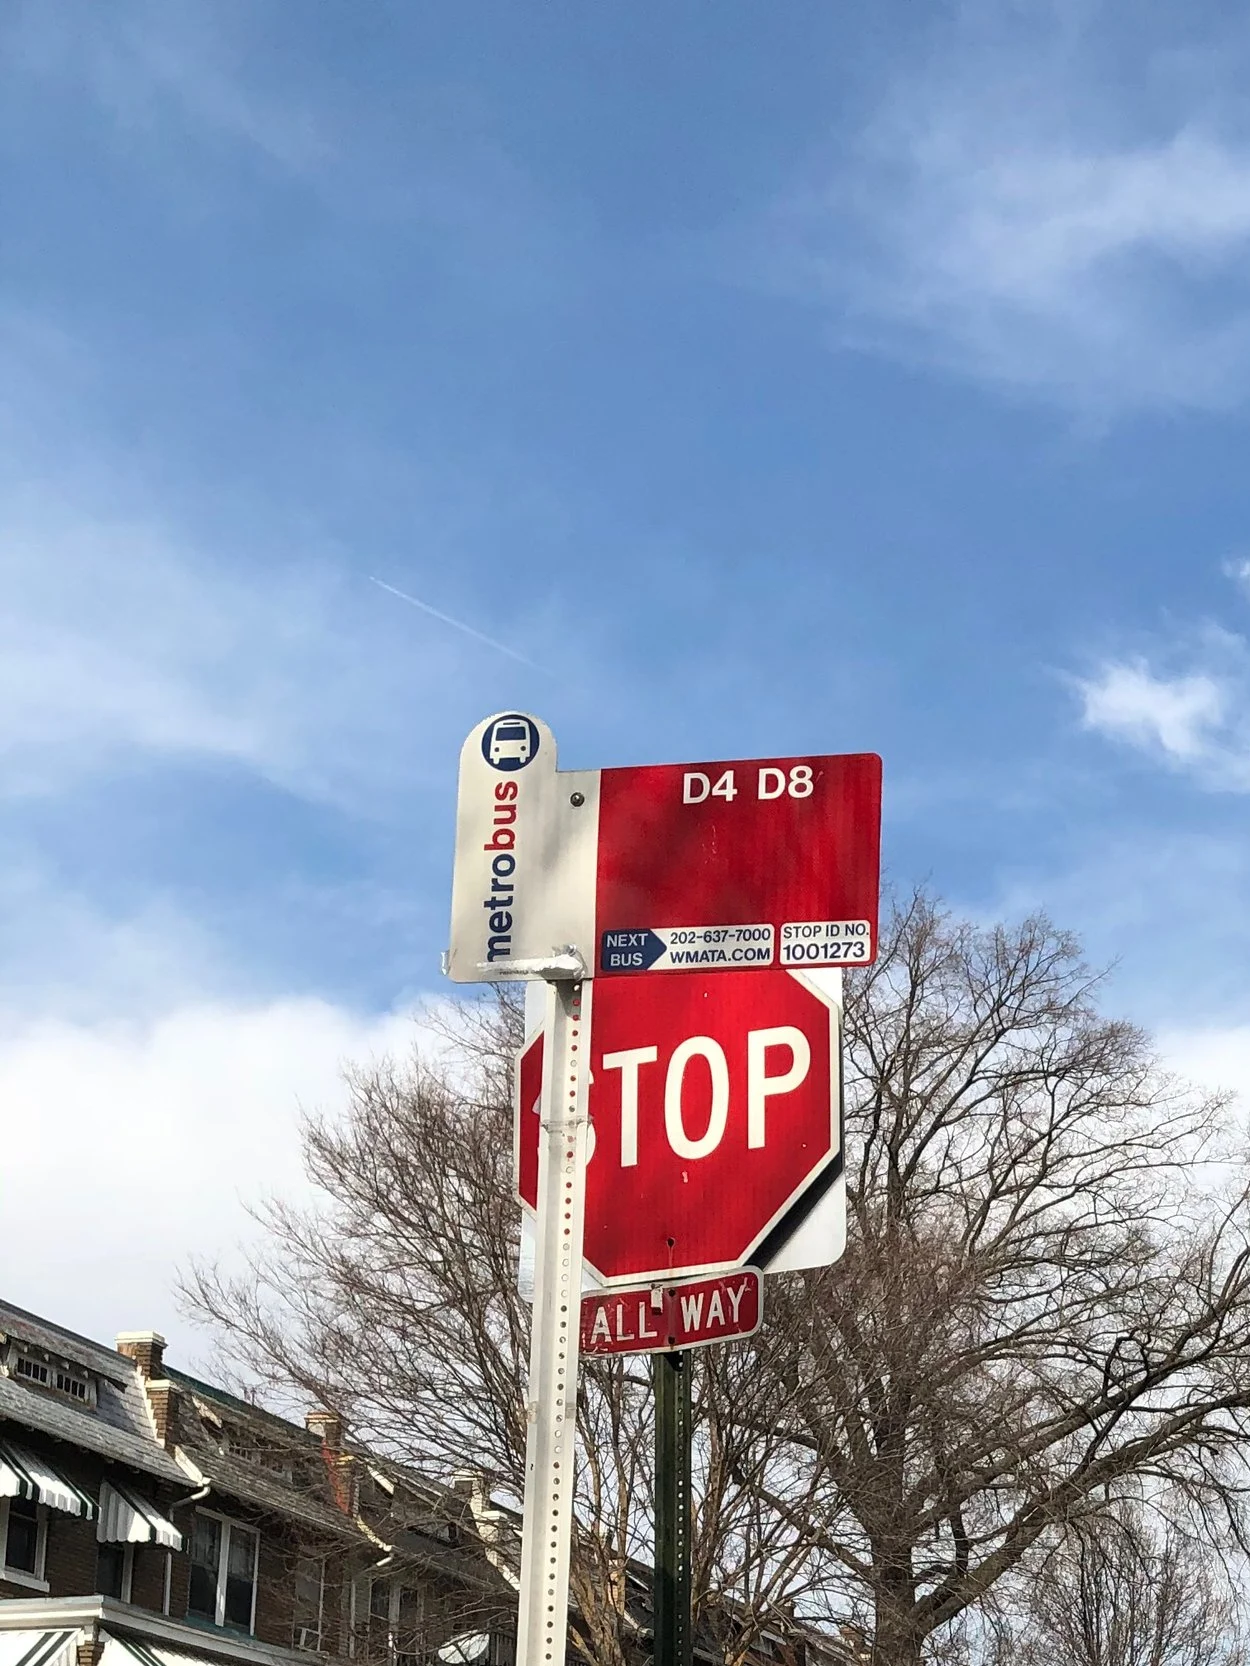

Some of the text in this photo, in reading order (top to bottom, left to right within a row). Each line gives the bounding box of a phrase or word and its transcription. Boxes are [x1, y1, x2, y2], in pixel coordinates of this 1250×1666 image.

[682, 765, 814, 805] D4 D8
[670, 928, 771, 946] 202-637-7000
[783, 922, 870, 940] STOP ID NO.
[606, 932, 649, 949] NEXT
[609, 952, 643, 968] BUS
[670, 947, 771, 965] WMATA.COM
[782, 941, 866, 961] 1001273
[533, 1025, 812, 1171] TOP
[590, 1284, 748, 1345] ALL WAY
